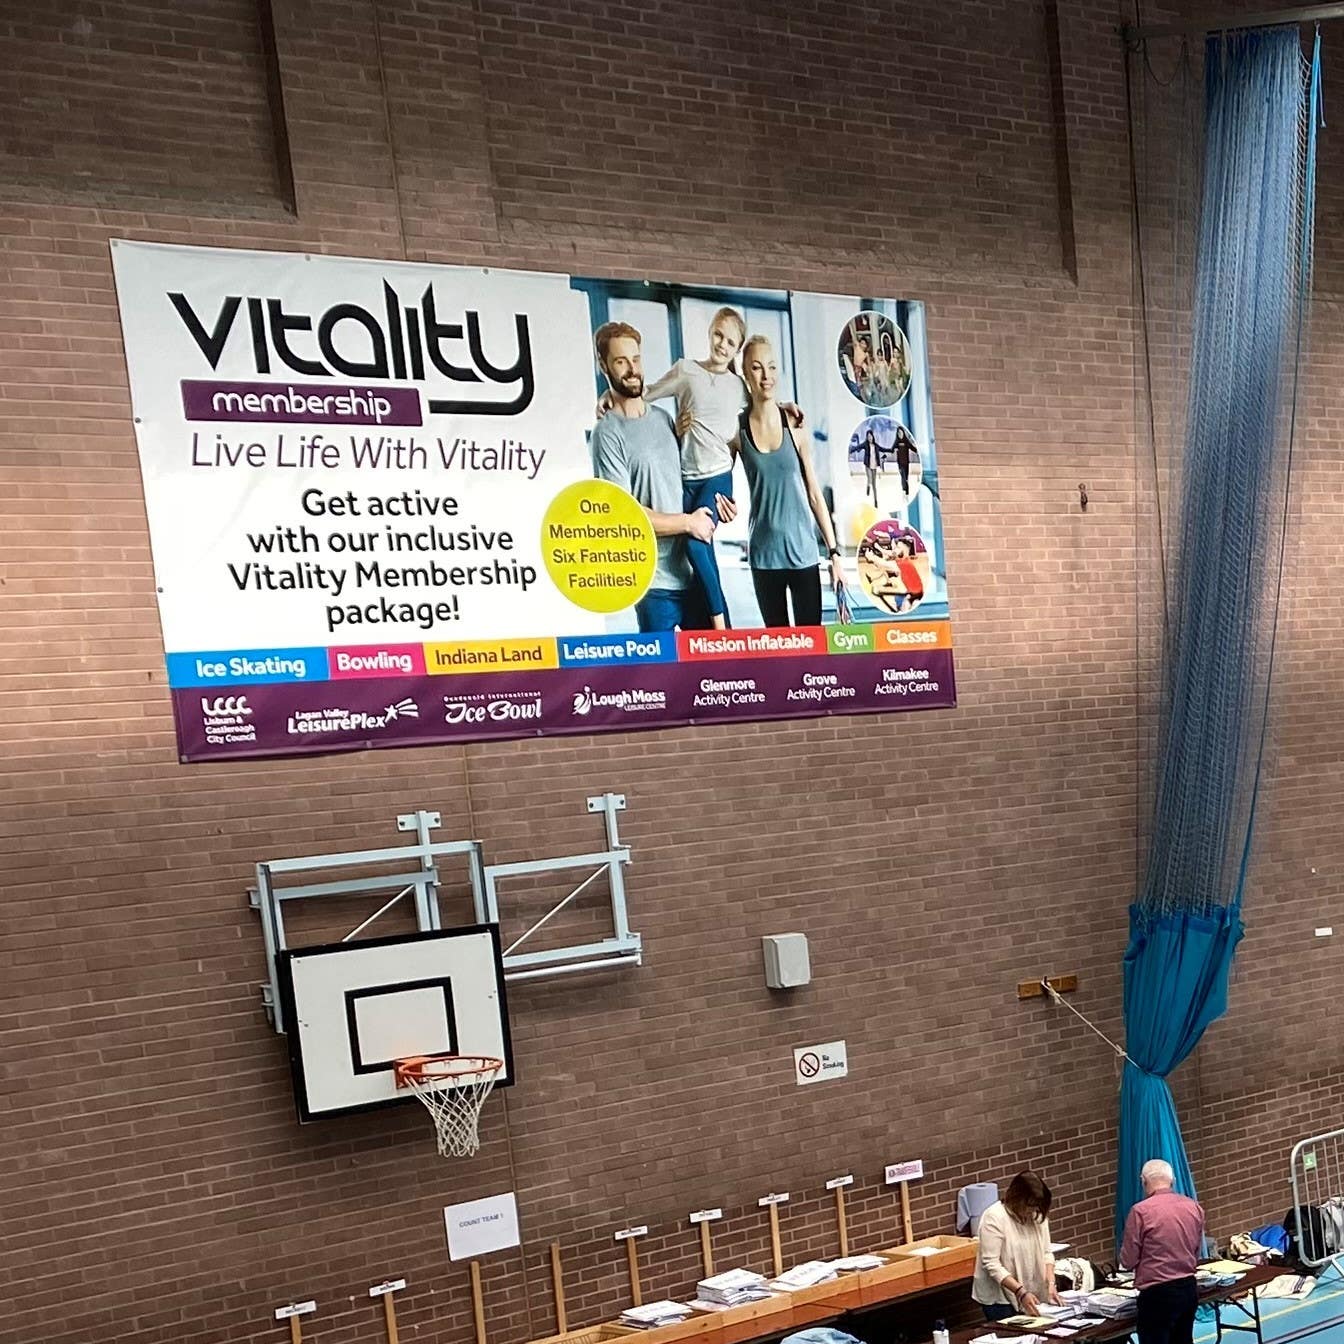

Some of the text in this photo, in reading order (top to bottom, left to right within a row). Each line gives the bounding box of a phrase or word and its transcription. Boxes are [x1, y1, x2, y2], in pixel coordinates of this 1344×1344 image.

[212, 386, 392, 425] membership
[192, 432, 546, 480] Live Life With Vitality
[301, 488, 459, 517] Get active
[579, 500, 611, 514] One
[247, 525, 514, 553] with our inclusive
[549, 523, 646, 542] Membership,
[552, 548, 647, 564] Six Fantastic
[228, 558, 537, 598] Vitality Membership
[569, 573, 637, 590] Facilities!
[326, 595, 460, 632] package!
[689, 634, 814, 653] Mission Inflatable
[833, 631, 868, 650] Gym
[886, 629, 938, 645] Classes
[435, 646, 543, 666] Indiana Land
[563, 639, 661, 660] Leisure Pool
[196, 656, 306, 678] Ice Skating
[336, 652, 413, 673] Bowling
[803, 672, 838, 686] Grove
[882, 667, 930, 682] Kilmakee
[700, 678, 756, 692] Glenmore
[787, 685, 856, 701] Activity Centre
[874, 680, 939, 695] Activity Centre
[591, 689, 666, 708] Lough Moss
[693, 691, 766, 707] Activity Centre
[295, 708, 350, 721] Lagan Valley
[445, 698, 543, 723] Ice Bowl
[287, 713, 385, 734] LeisurePlex
[458, 1217, 481, 1228] COUNT
